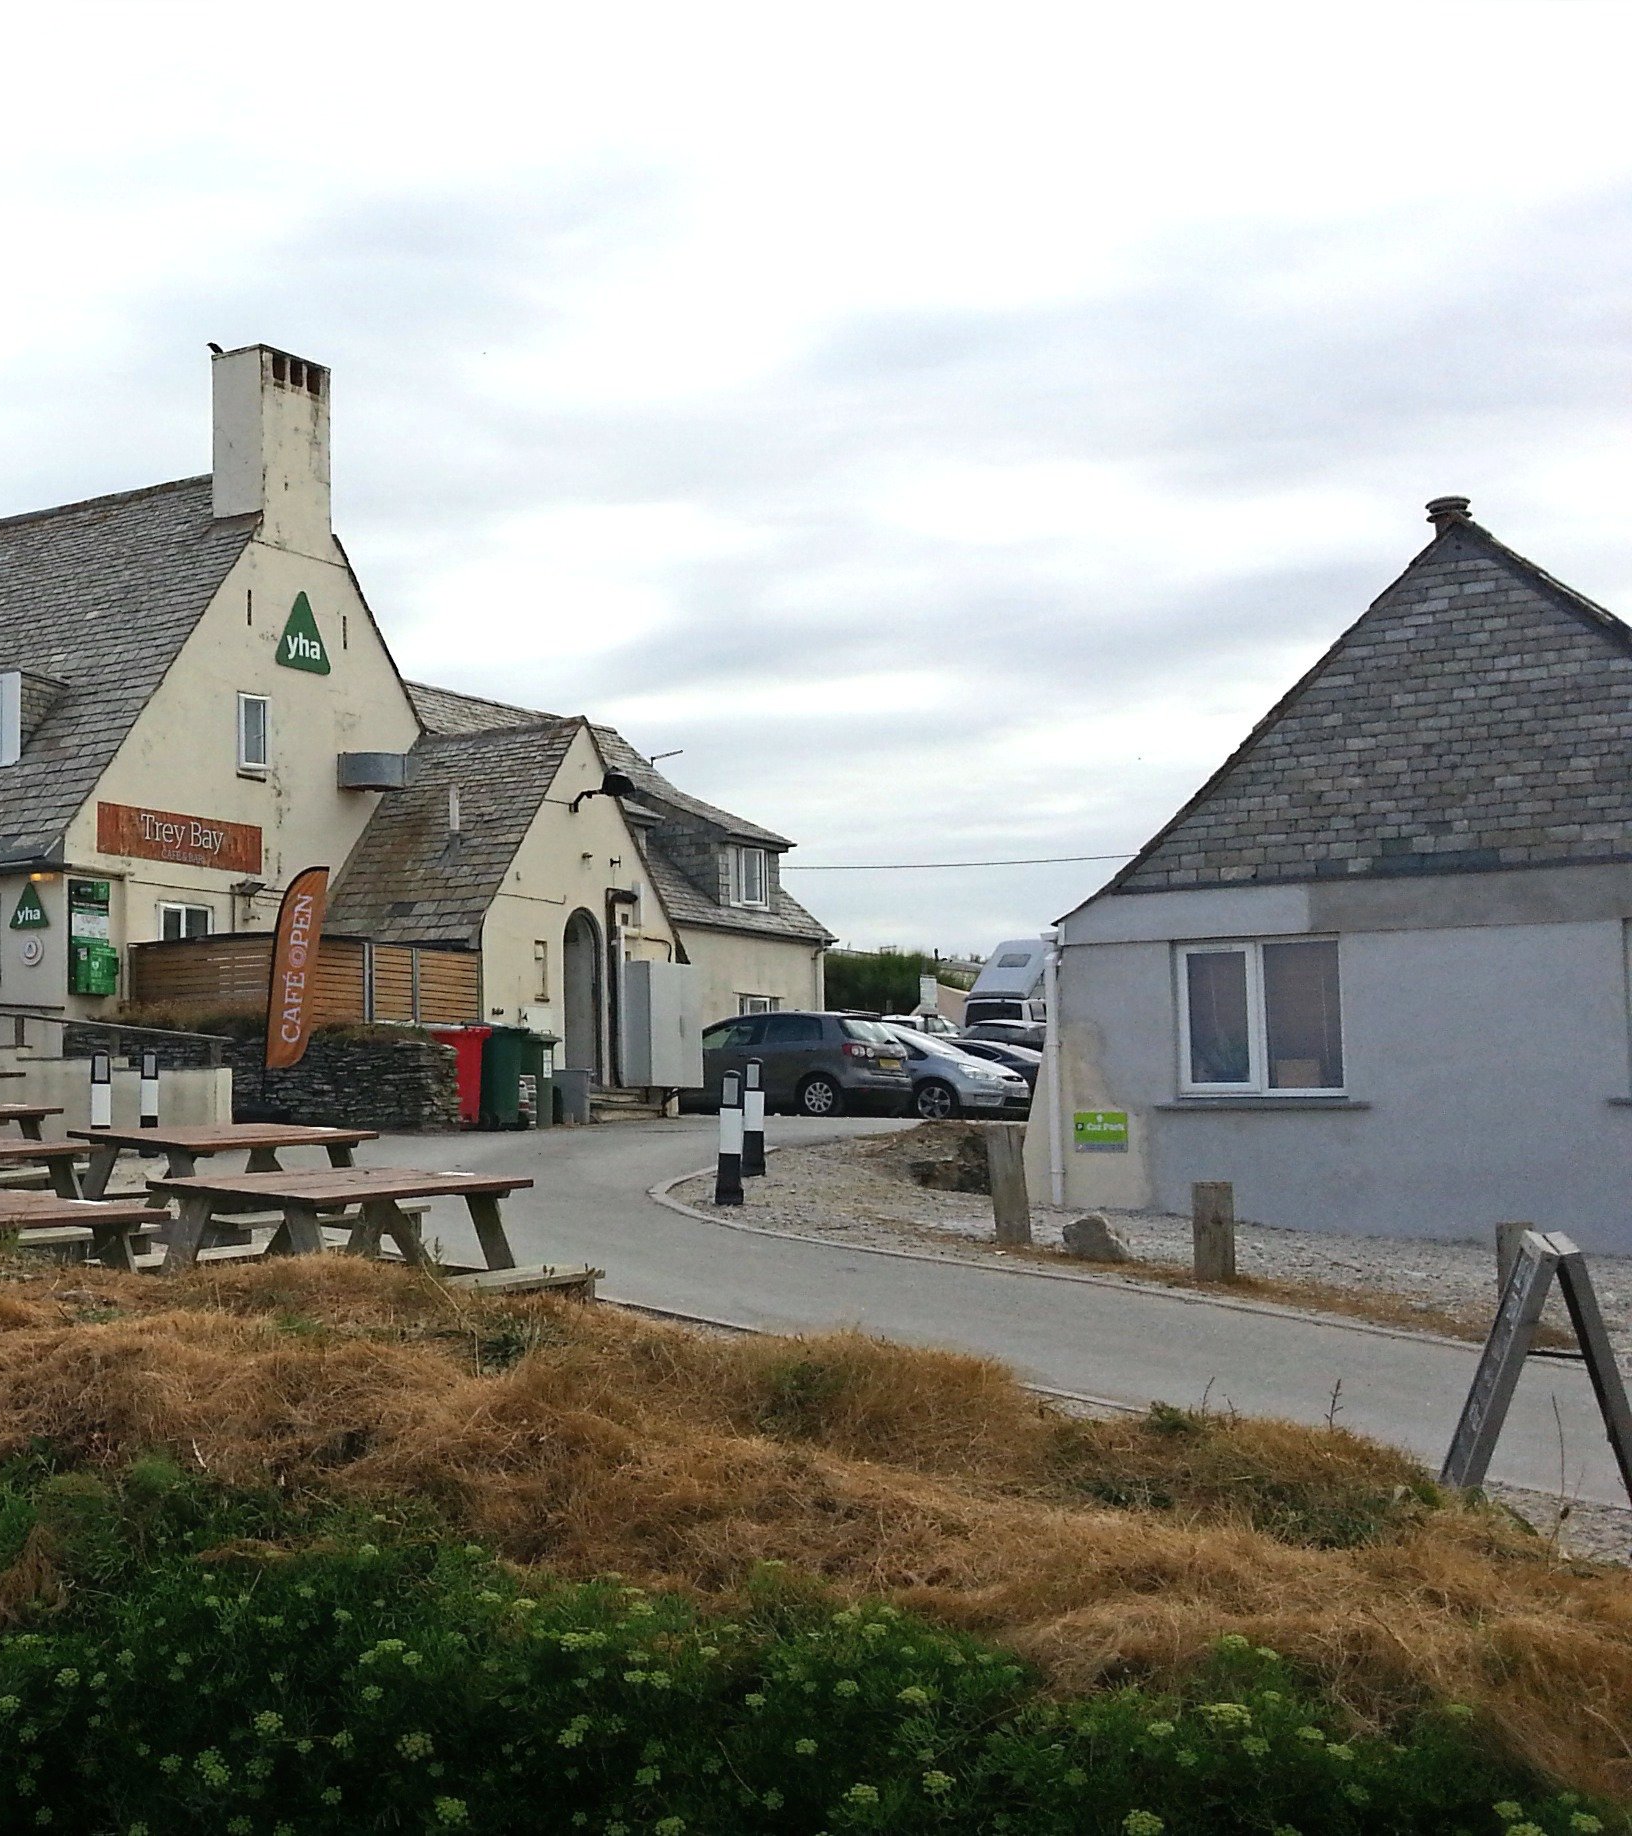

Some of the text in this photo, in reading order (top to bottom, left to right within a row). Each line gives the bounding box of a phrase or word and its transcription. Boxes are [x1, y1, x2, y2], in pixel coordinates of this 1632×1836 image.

[286, 631, 321, 660] yha
[141, 813, 224, 855] Trey Bay
[17, 906, 41, 925] yha
[281, 893, 314, 1044] CAFÉ OPEN
